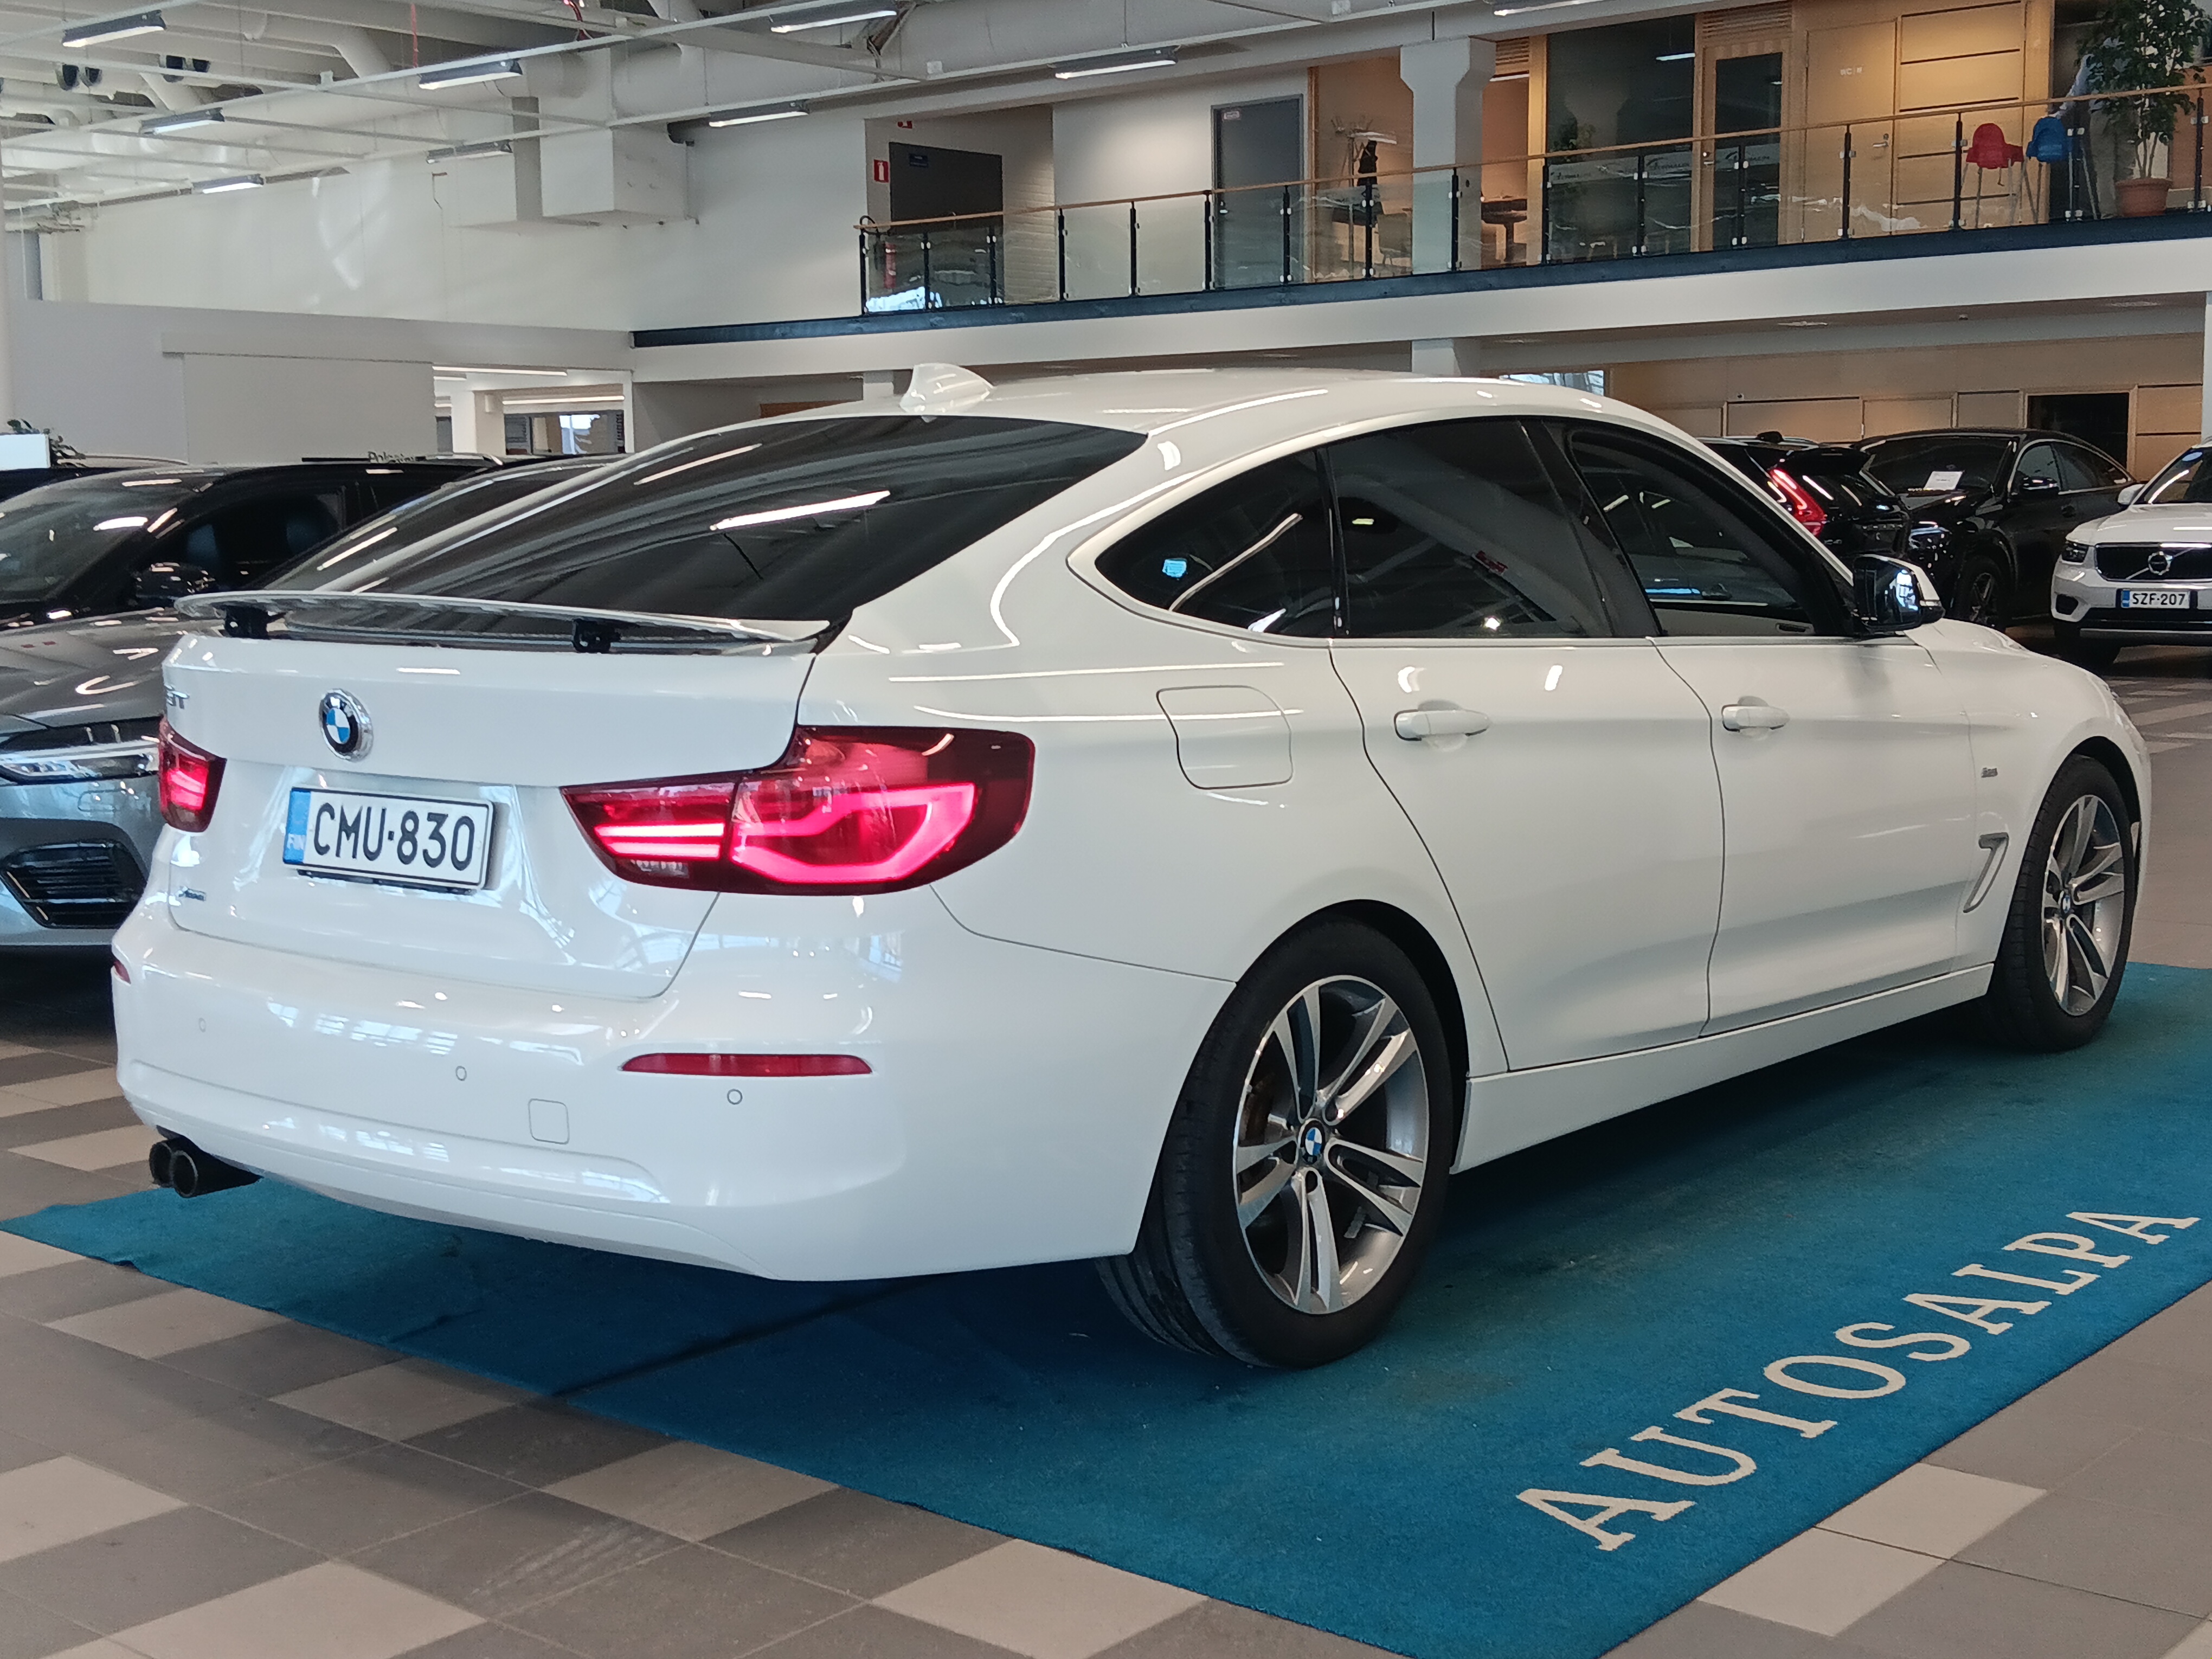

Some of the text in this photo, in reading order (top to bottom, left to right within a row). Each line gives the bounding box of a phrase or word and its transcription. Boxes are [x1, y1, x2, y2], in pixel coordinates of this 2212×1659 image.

[2132, 593, 2185, 606] SZF-207
[313, 802, 475, 871] CMU-830
[1516, 1211, 2202, 1552] AUTOSALPA
